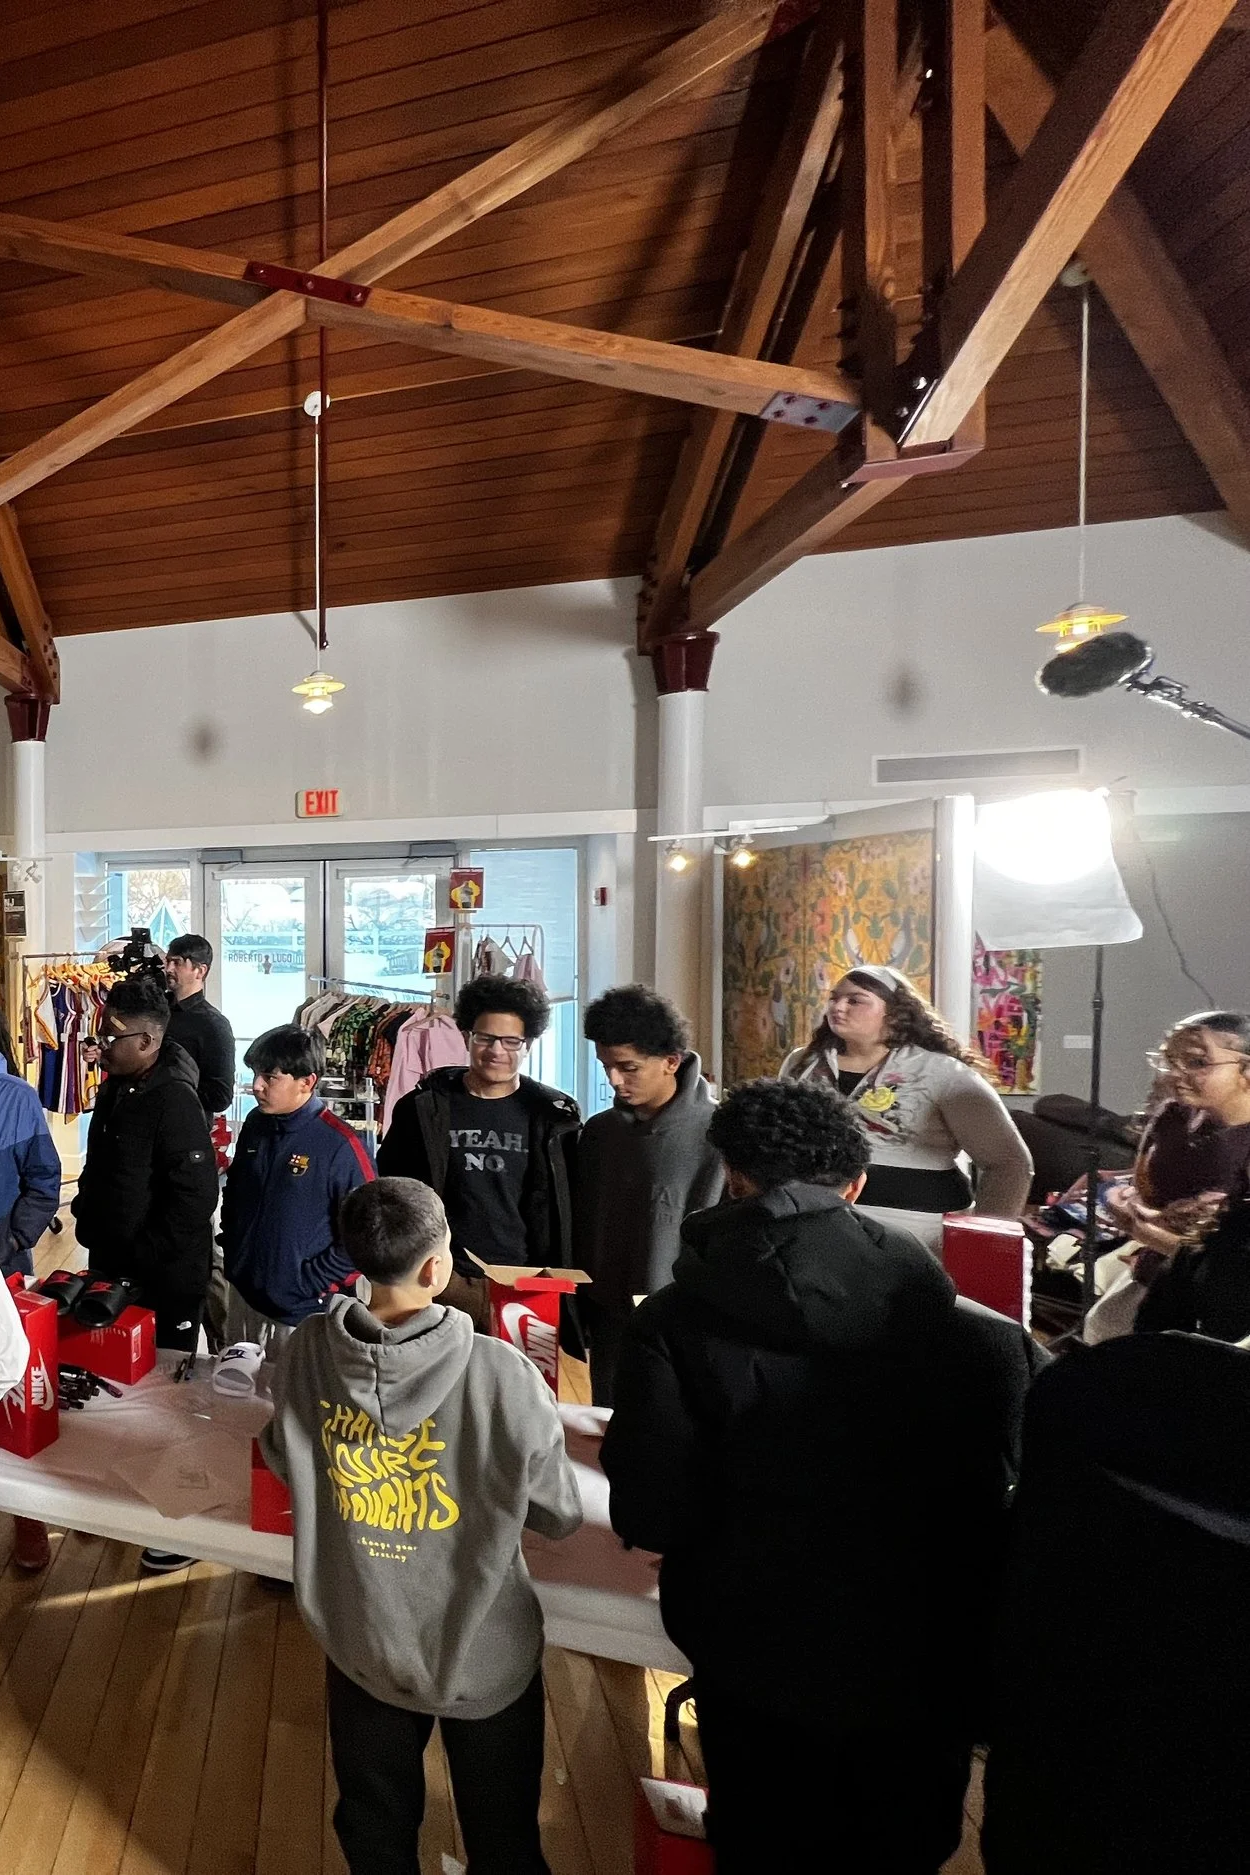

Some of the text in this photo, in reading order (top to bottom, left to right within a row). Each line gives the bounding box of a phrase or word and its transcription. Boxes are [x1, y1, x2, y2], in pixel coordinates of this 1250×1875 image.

[305, 790, 338, 815] EXIT
[228, 953, 293, 963] ROBERTO LUGO
[526, 1315, 558, 1378] NIKE
[31, 1366, 45, 1406] NIKE
